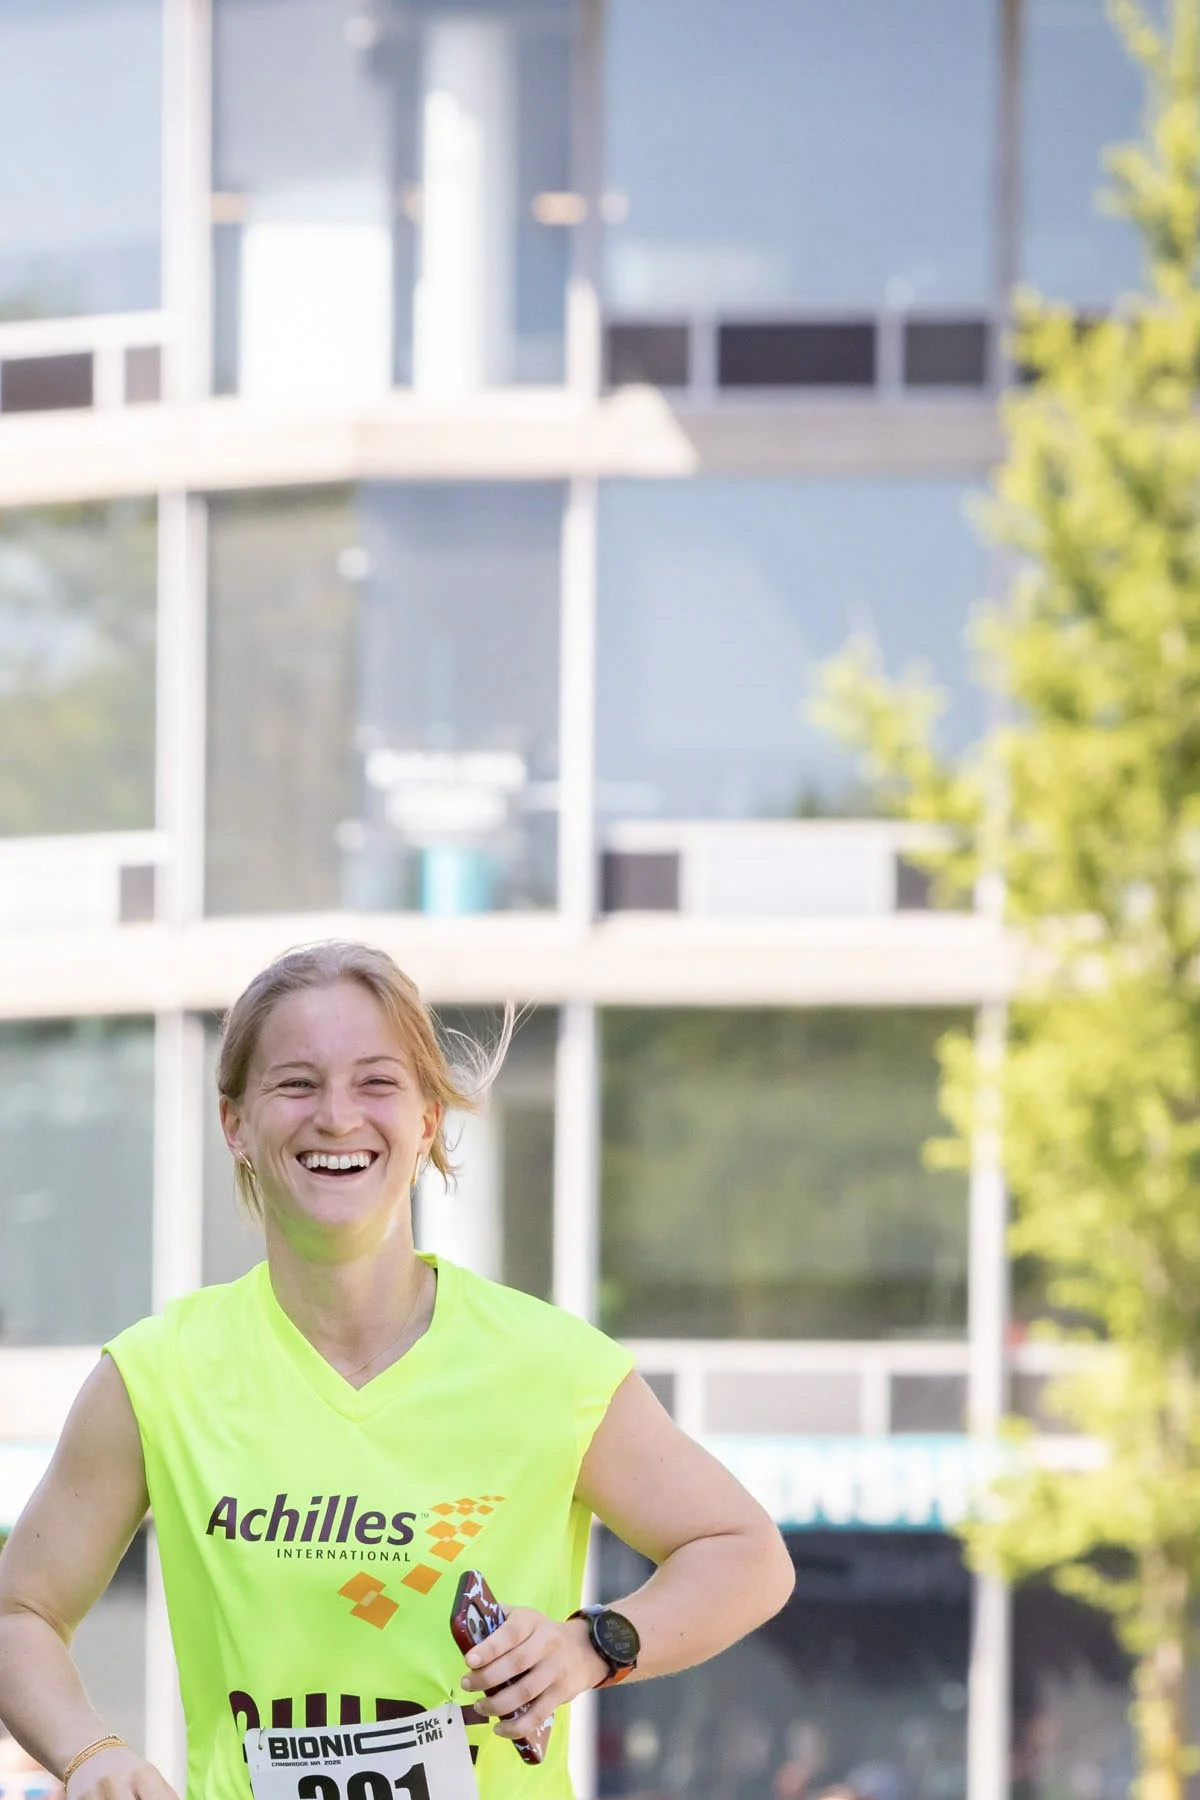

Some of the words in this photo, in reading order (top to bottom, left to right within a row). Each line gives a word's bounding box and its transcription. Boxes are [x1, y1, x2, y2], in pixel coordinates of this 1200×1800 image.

[206, 1493, 417, 1546] Achilles
[276, 1548, 412, 1563] INTERNATIONAL
[268, 1724, 417, 1760] BIONIC
